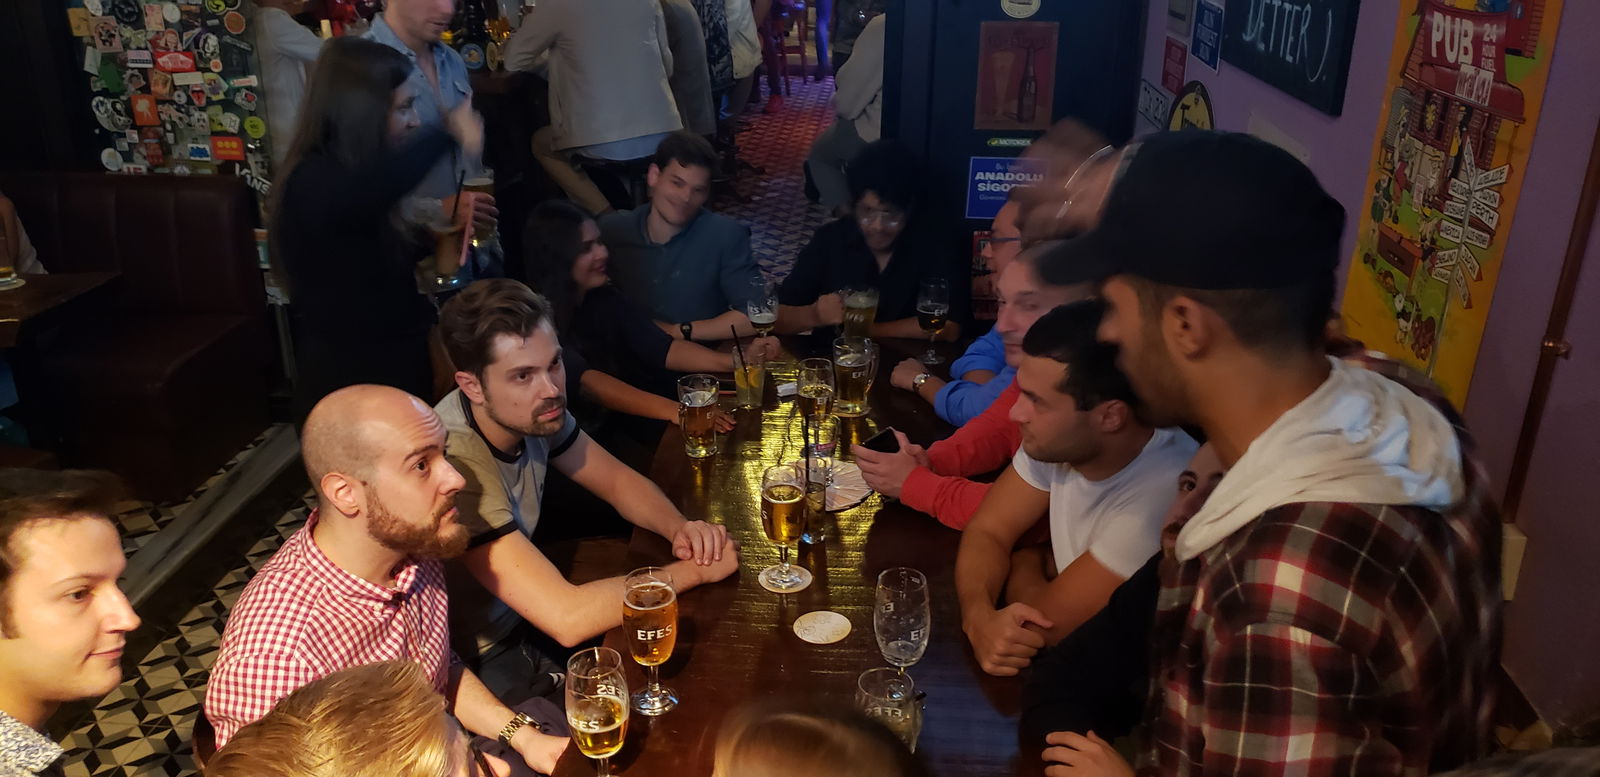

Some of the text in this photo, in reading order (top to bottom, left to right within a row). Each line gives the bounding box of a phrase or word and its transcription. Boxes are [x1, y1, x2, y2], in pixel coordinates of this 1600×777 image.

[1432, 11, 1473, 65] PUB
[1483, 23, 1497, 43] 24
[1472, 201, 1495, 225] PERTH
[637, 624, 673, 641] EFES
